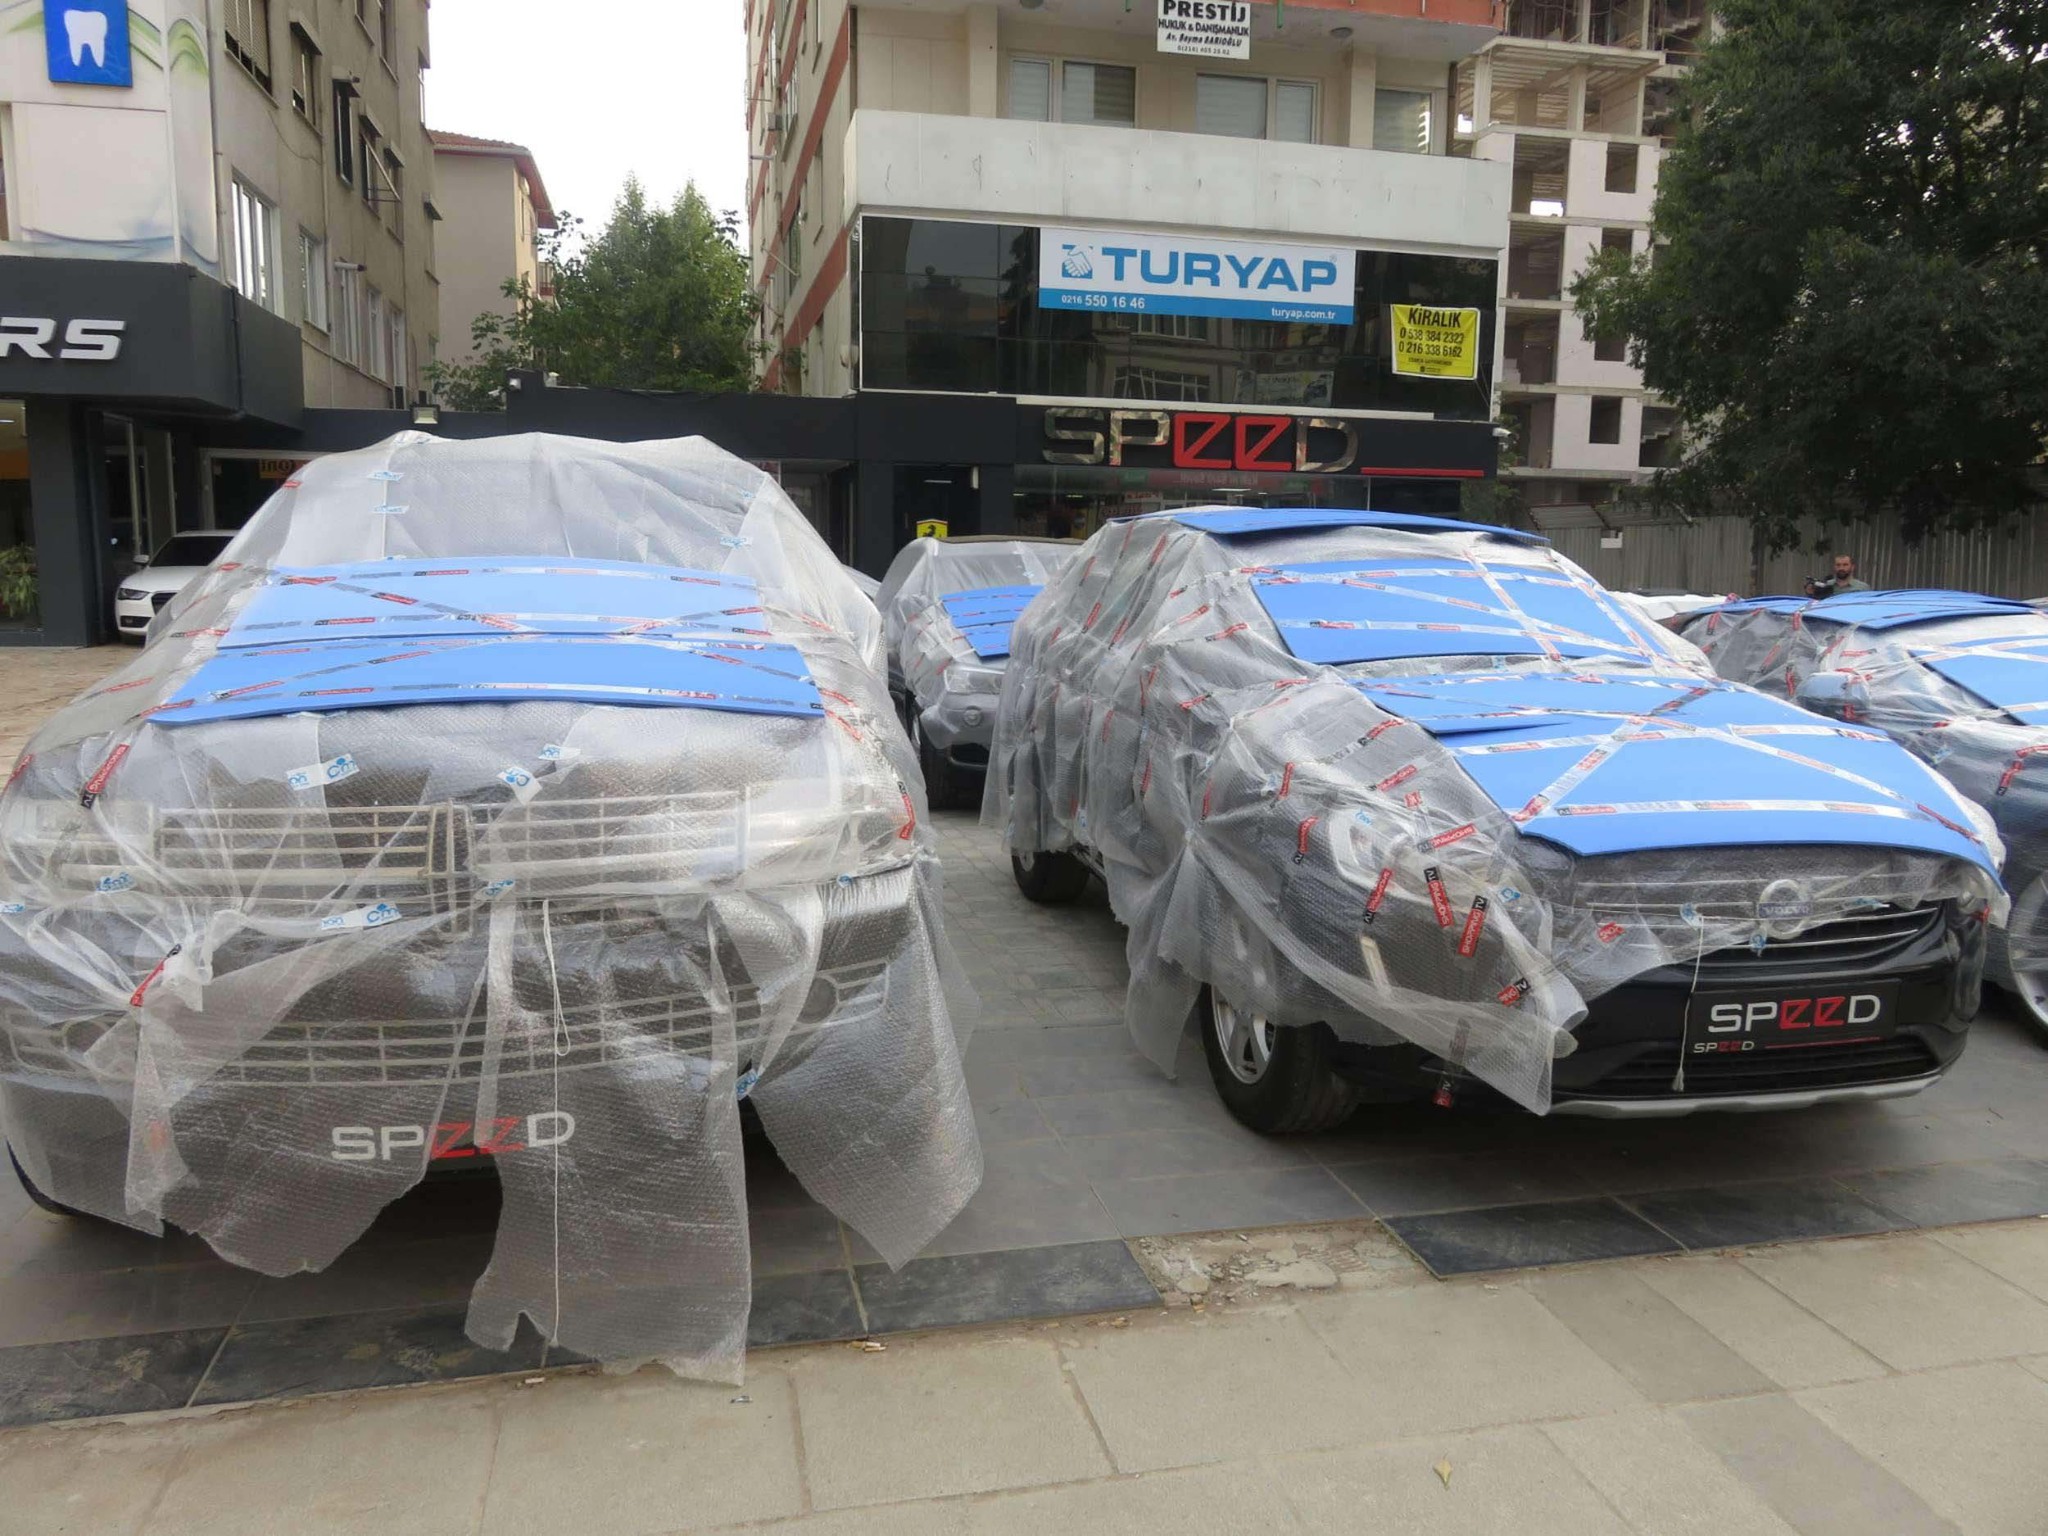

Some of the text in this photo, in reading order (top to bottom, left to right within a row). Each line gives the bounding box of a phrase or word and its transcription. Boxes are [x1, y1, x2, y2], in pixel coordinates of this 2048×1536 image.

[1158, 18, 1187, 30] HUKUK
[1102, 247, 1337, 292] TURYAP
[1061, 294, 1145, 309] 0216 550 16 46
[1271, 305, 1336, 320] turyap.com.tr
[1400, 327, 1406, 338] 0
[1399, 341, 1404, 352] 0
[1406, 342, 1423, 354] 216
[1708, 994, 1881, 1033] SPEED
